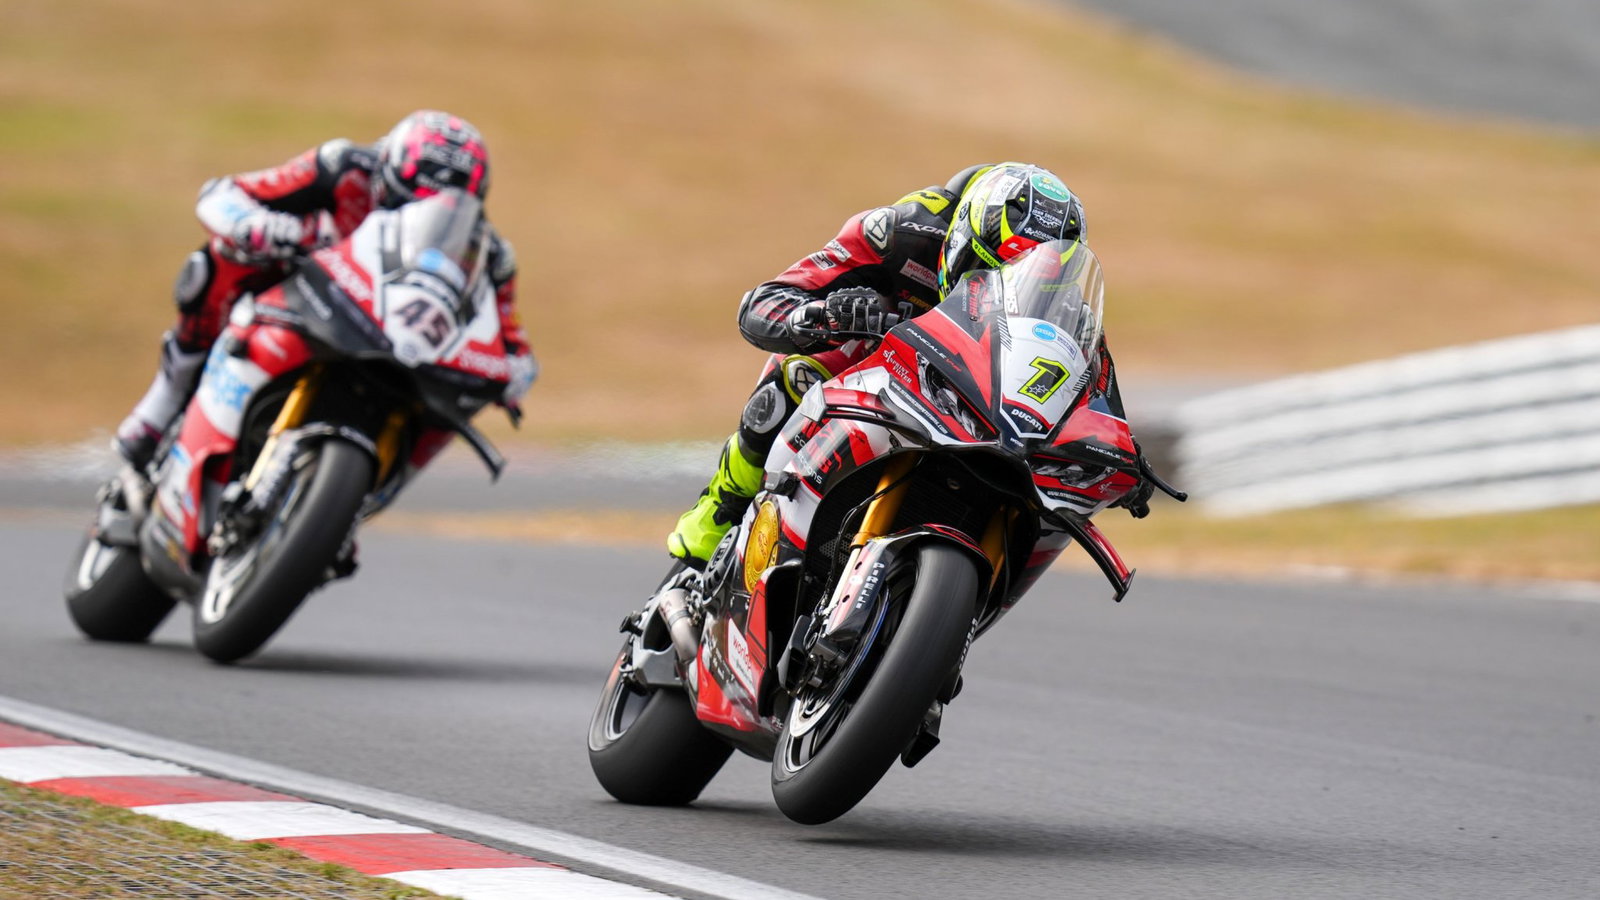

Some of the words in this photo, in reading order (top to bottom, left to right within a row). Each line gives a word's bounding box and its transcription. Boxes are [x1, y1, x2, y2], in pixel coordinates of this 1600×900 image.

[900, 221, 947, 236] IXON
[906, 261, 938, 284] worldpa
[395, 298, 451, 349] 45
[906, 327, 948, 360] PANIGALE
[1011, 408, 1043, 431] DUCATI
[1085, 445, 1121, 459] PANIGALE
[856, 562, 886, 609] PIRELLI
